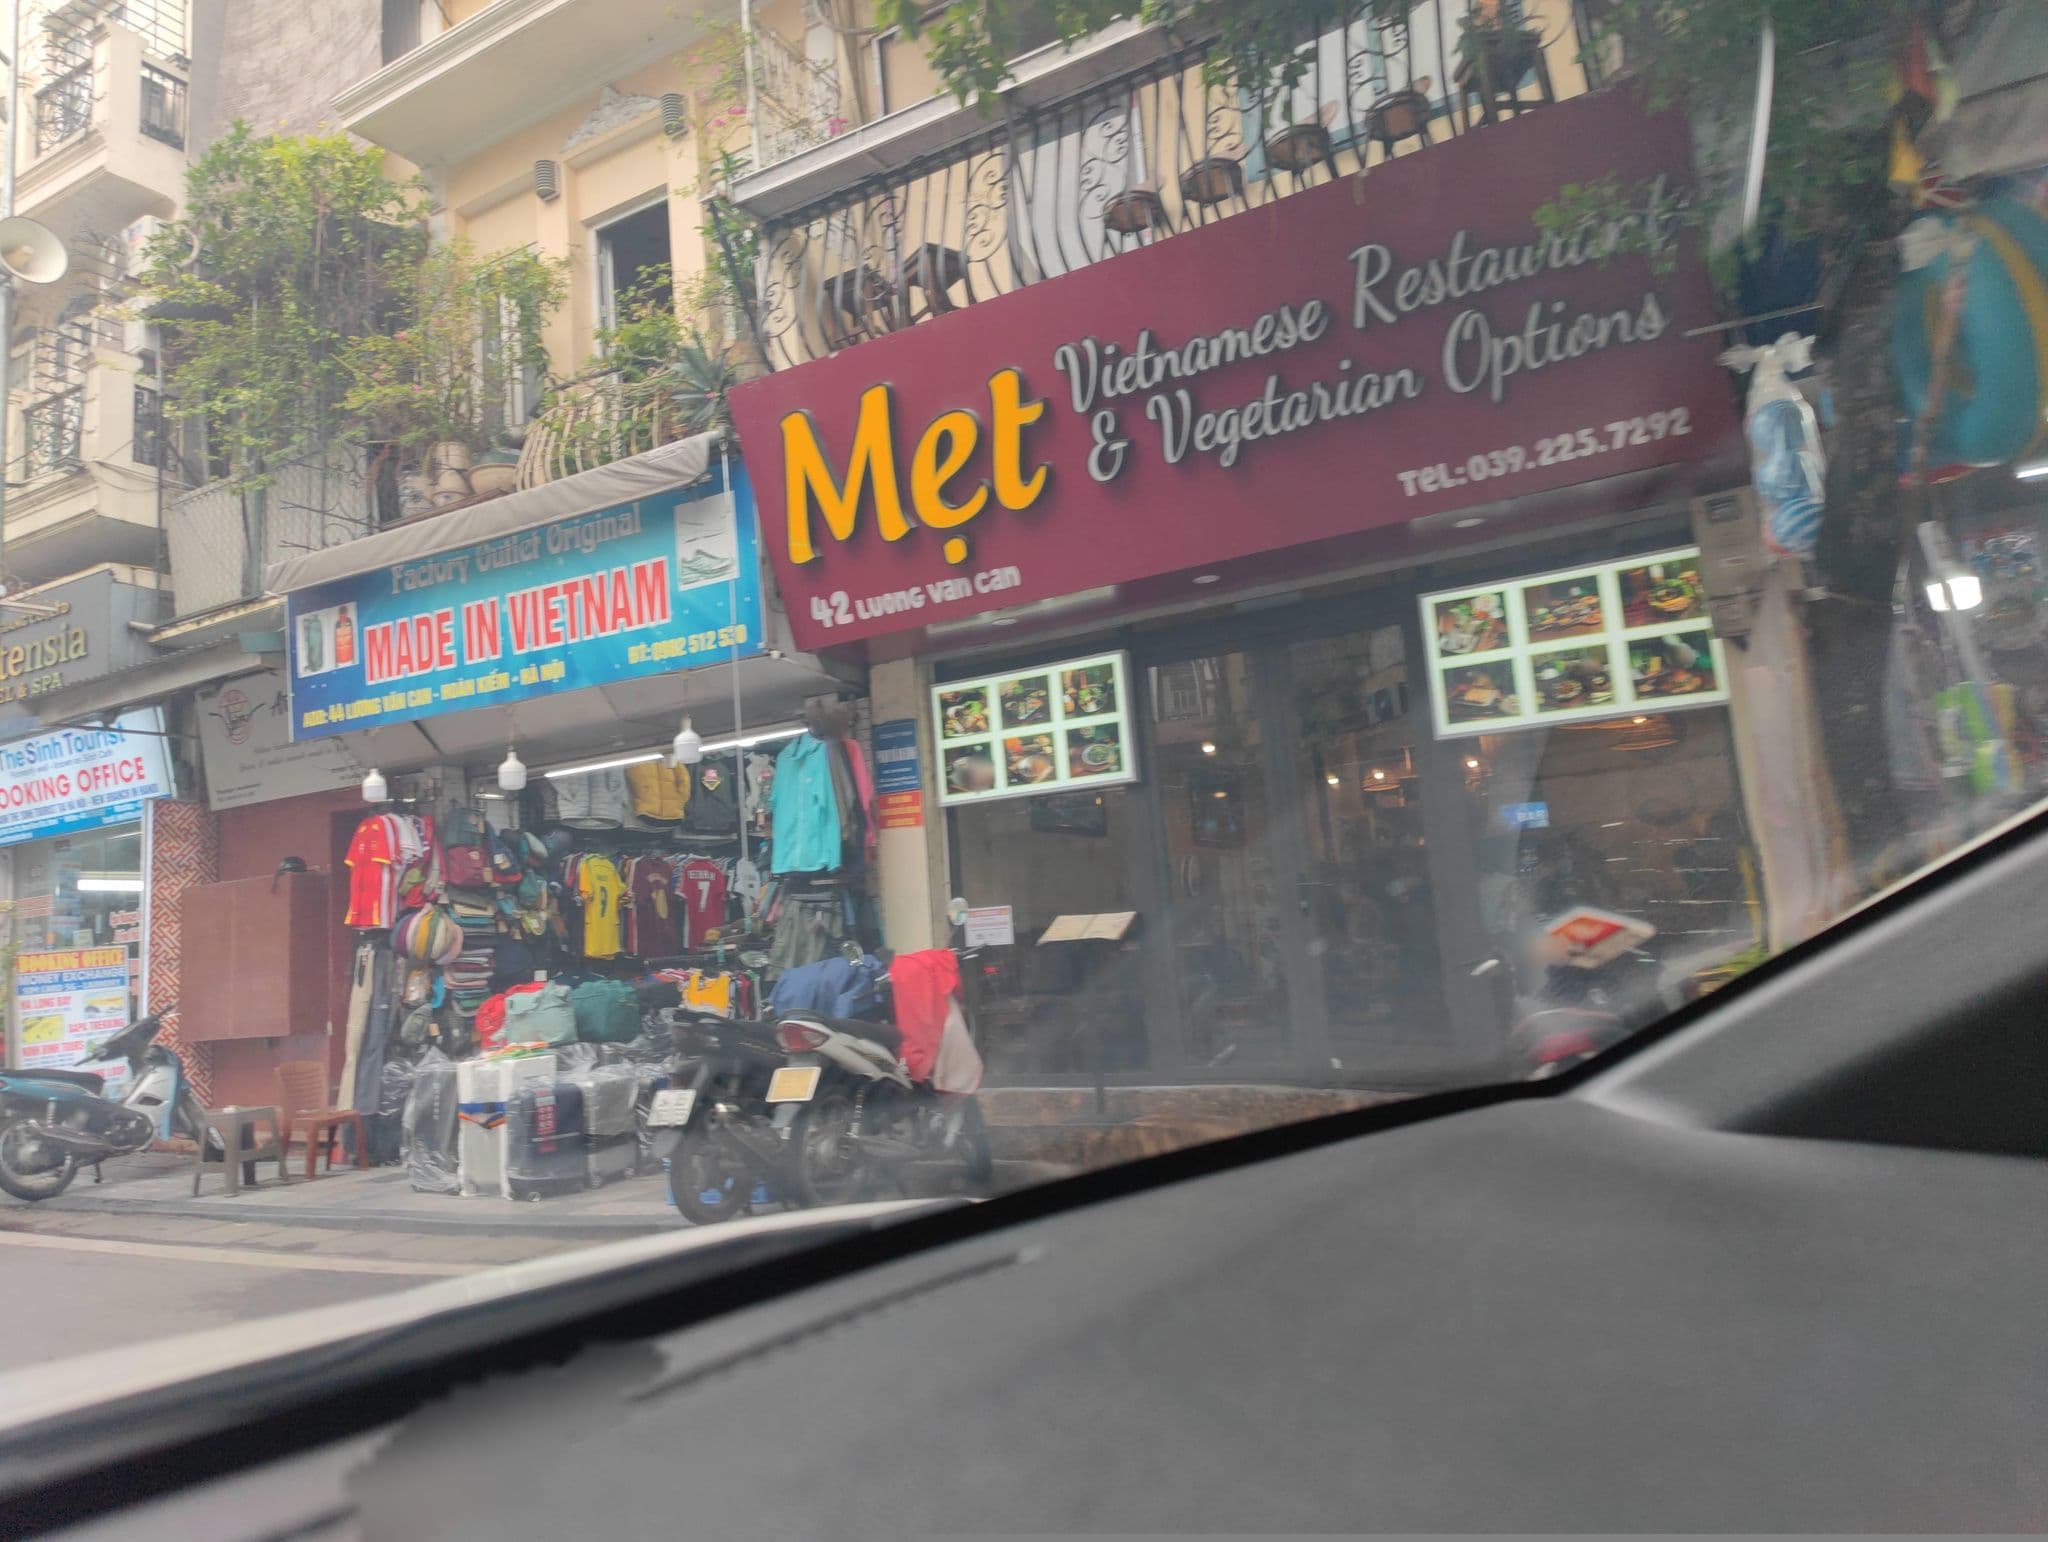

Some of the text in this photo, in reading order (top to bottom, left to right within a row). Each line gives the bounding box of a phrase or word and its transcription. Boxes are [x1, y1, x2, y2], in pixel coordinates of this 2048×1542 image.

[1055, 300, 1327, 413] Vietnamese
[1088, 294, 1668, 483] & Vegetarian Options
[781, 368, 1050, 565] Mẹt
[391, 555, 469, 594] Factory
[546, 503, 641, 555] Original
[365, 556, 671, 685] MADE IN VIETNAM
[810, 591, 854, 628] 42
[77, 757, 146, 792] OFFICE
[698, 881, 710, 912] 7
